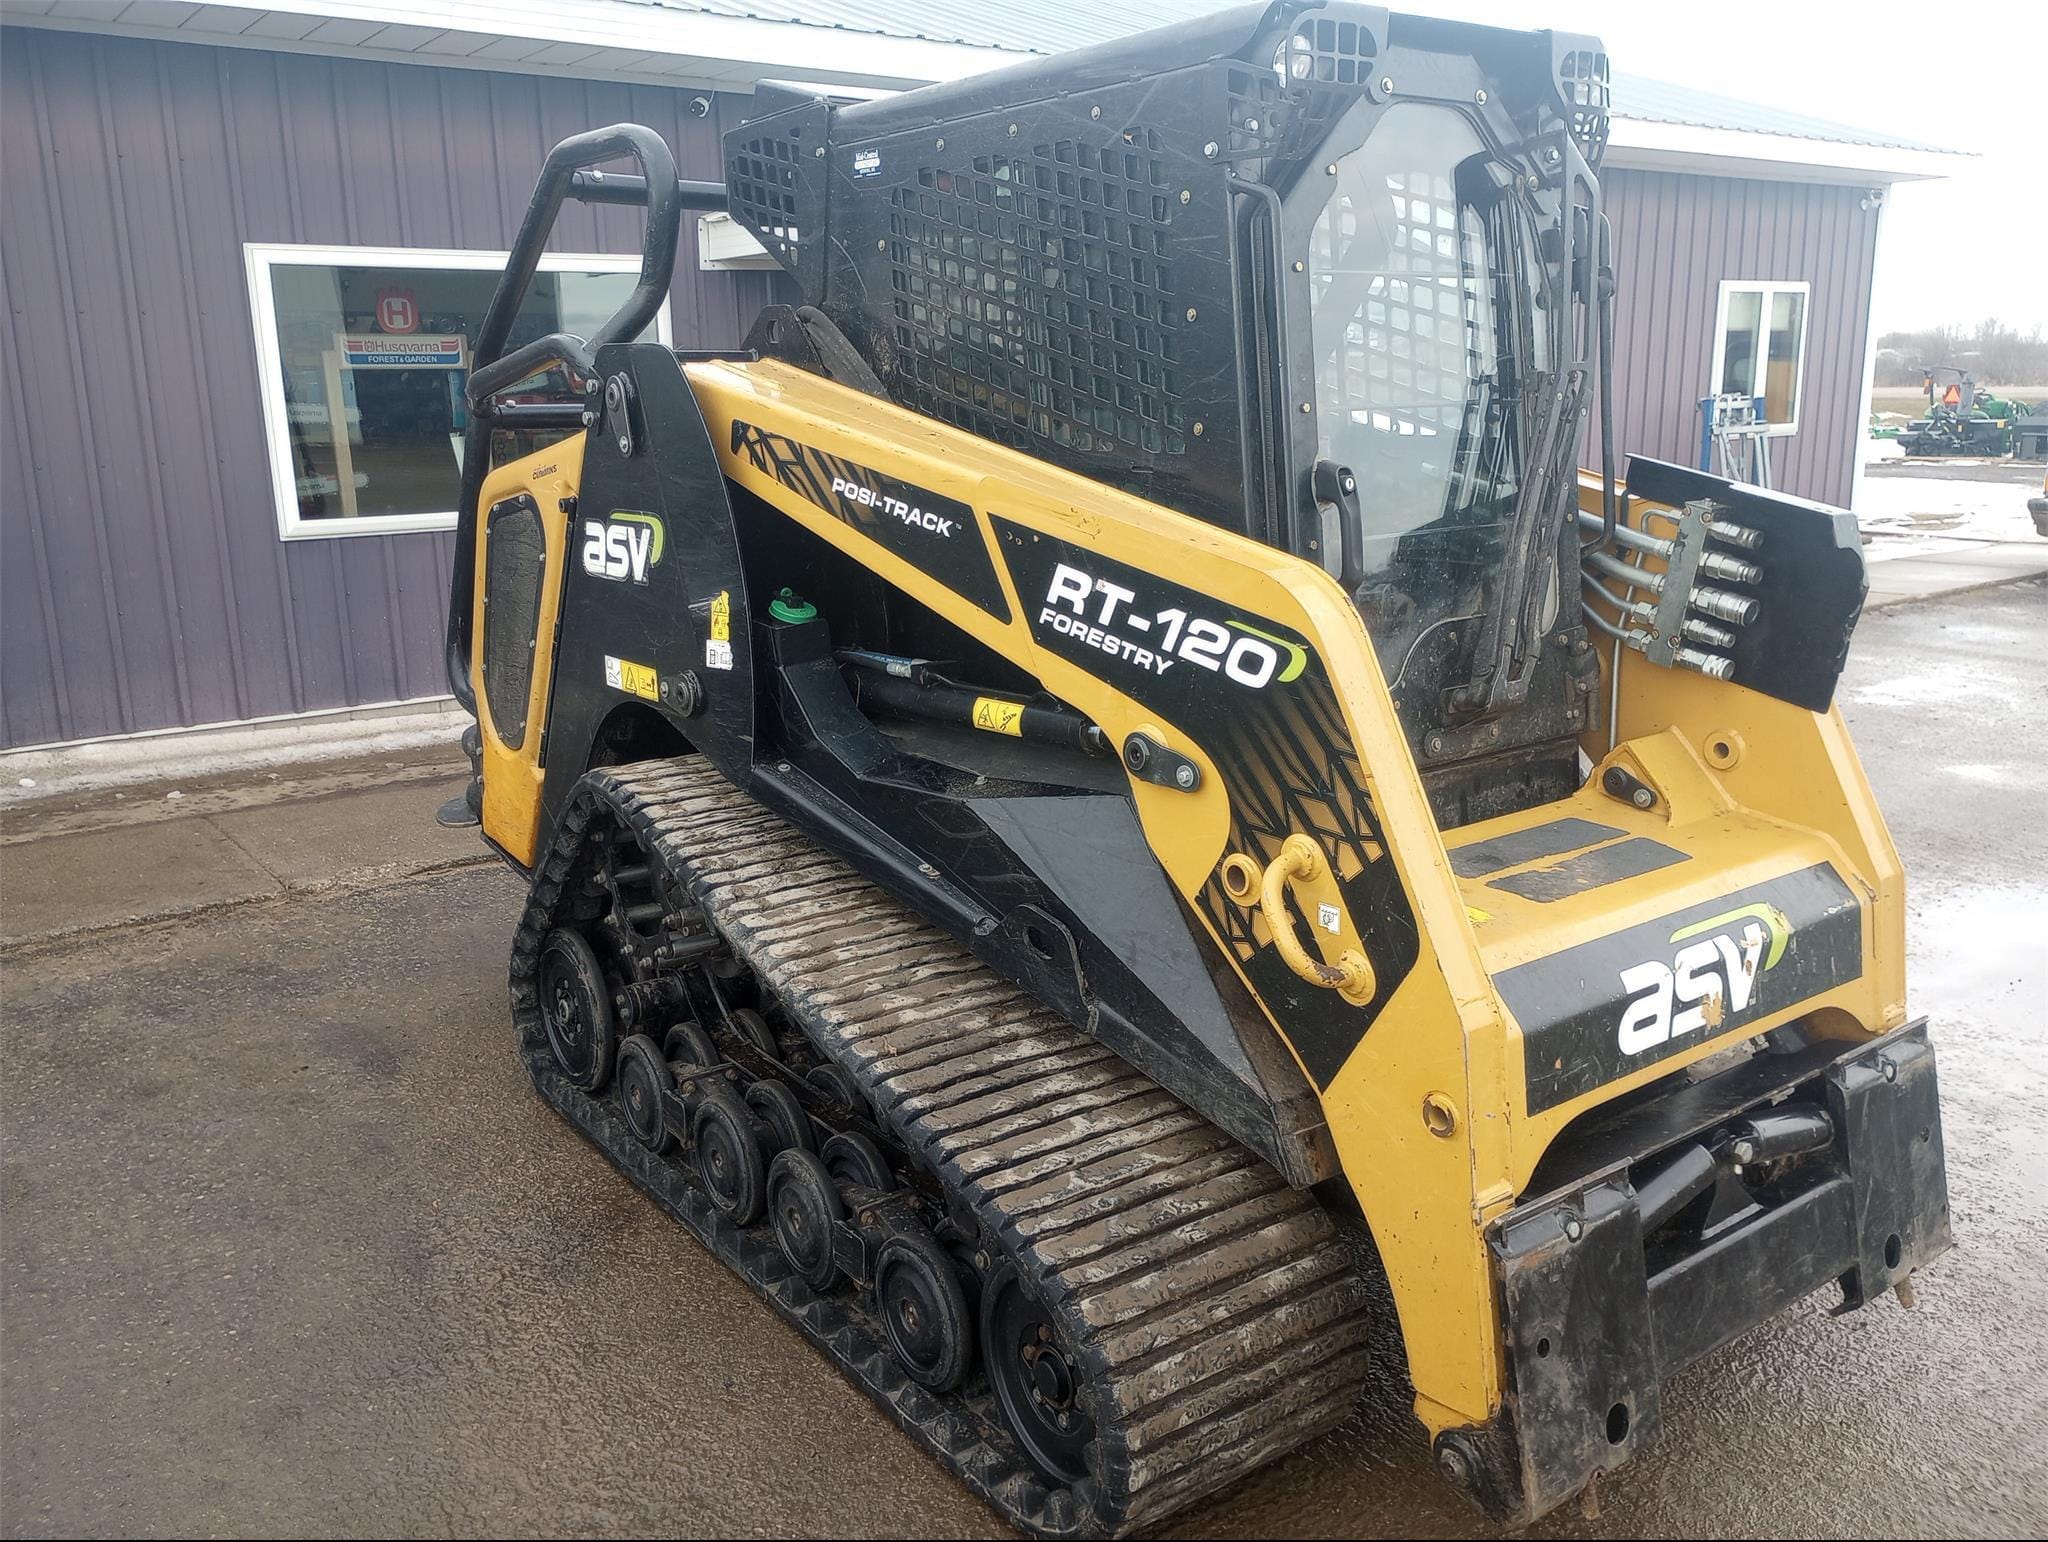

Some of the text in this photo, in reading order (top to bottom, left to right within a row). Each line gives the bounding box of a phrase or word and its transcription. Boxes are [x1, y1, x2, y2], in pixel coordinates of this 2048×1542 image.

[375, 341, 441, 353] Husqvarna
[831, 477, 953, 537] POSI-TRACK
[1039, 607, 1174, 676] FORESTRY
[1046, 563, 1278, 689] RT-120
